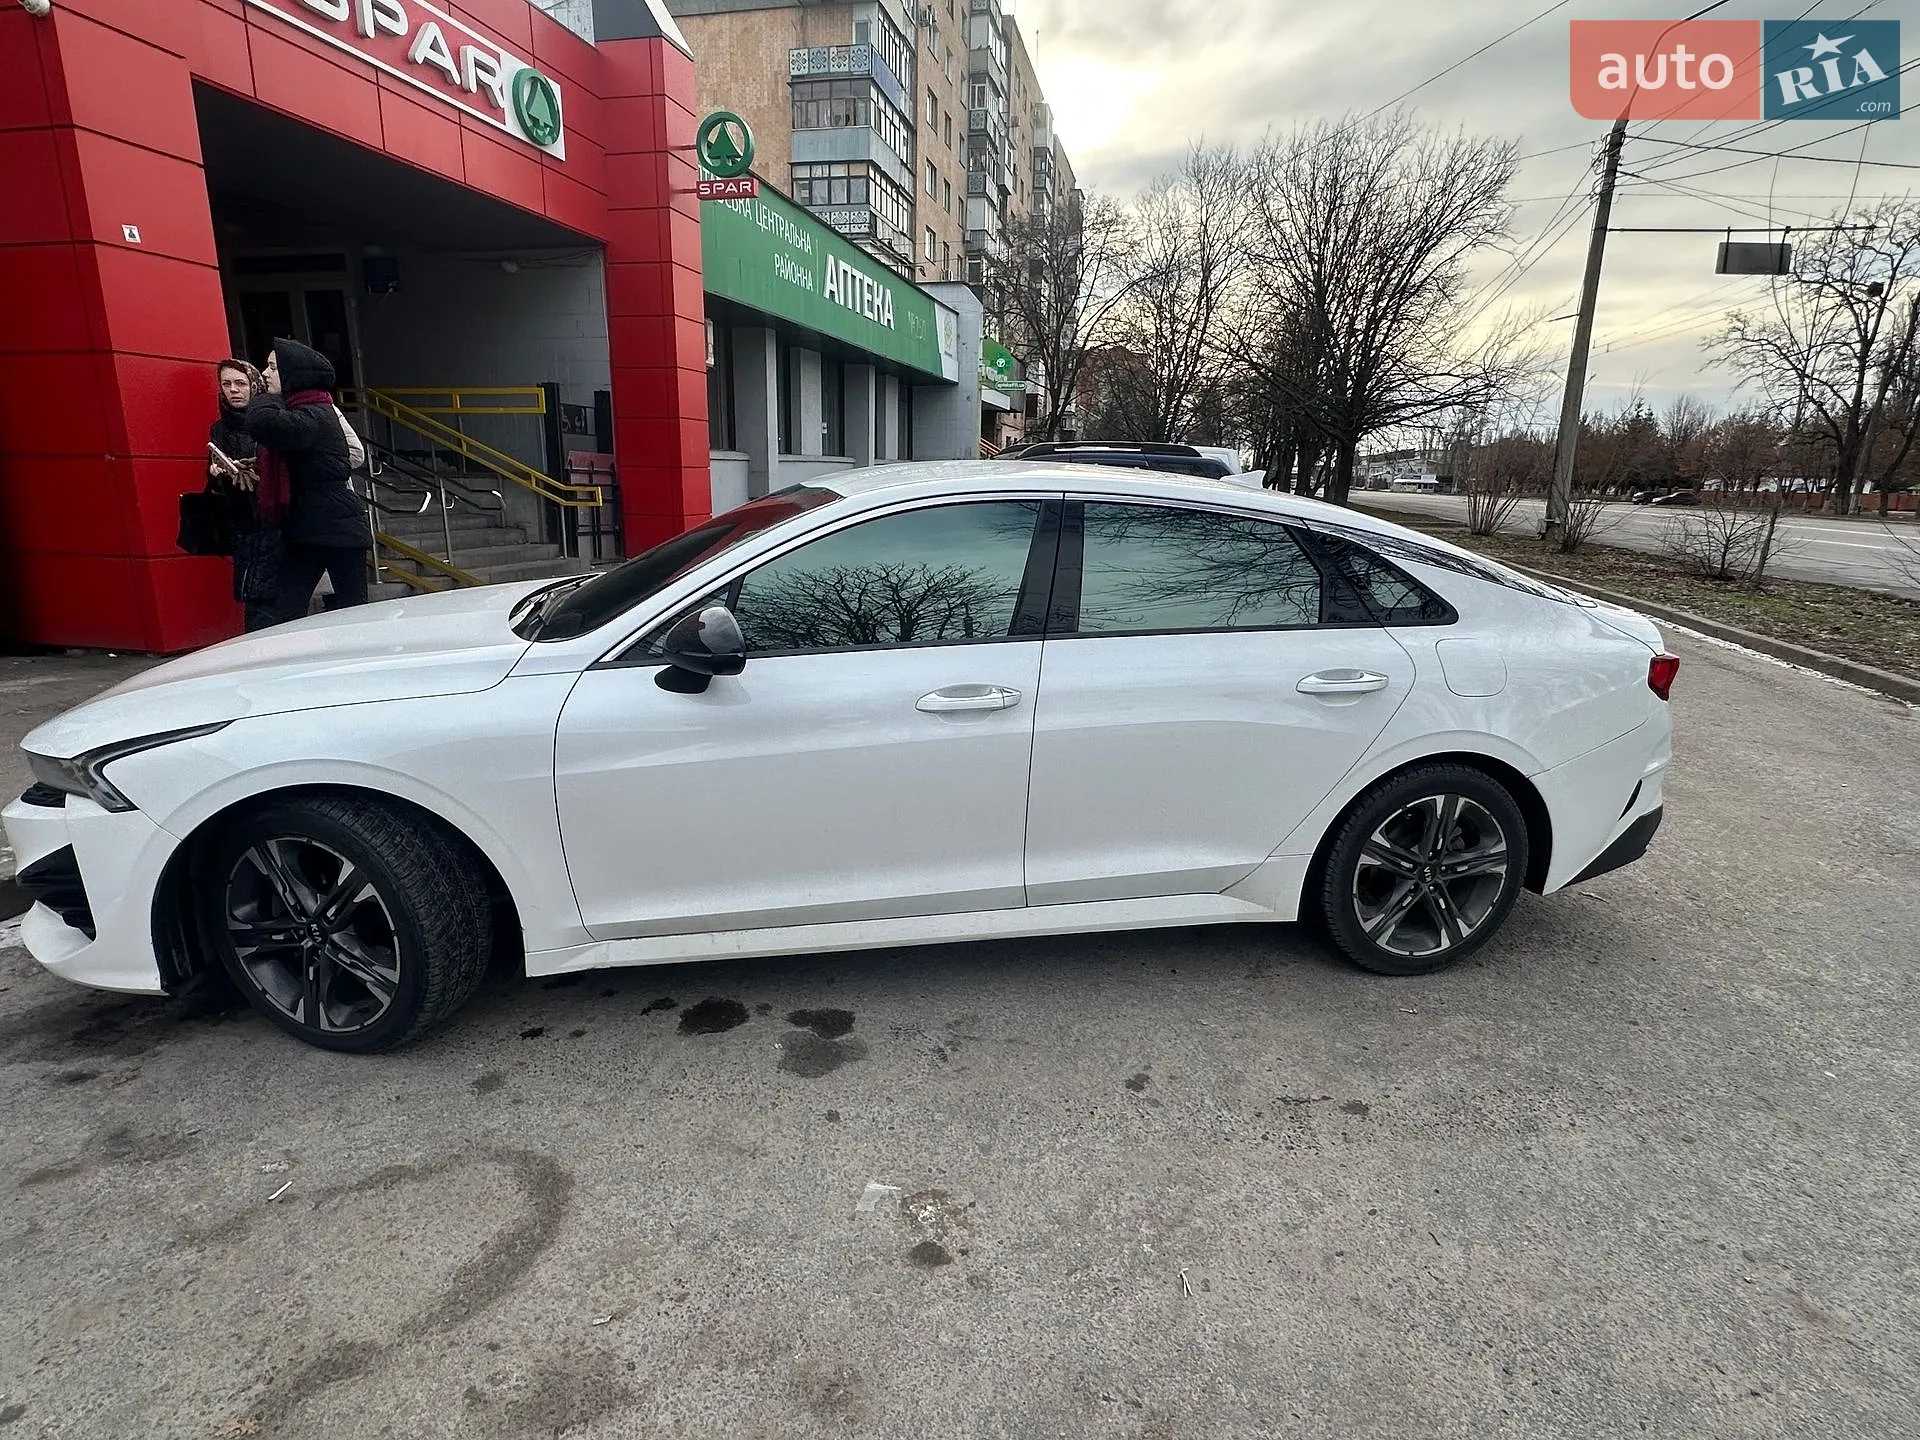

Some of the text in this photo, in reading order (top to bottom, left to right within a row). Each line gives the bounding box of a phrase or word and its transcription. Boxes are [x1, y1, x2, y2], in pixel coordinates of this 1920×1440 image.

[699, 181, 752, 195] SPAR
[755, 200, 812, 255] ЦЕНТРАЛЬНА
[774, 252, 814, 292] РАЙОННА
[823, 253, 895, 331] АПТЕКА
[310, 923, 322, 943] KIA
